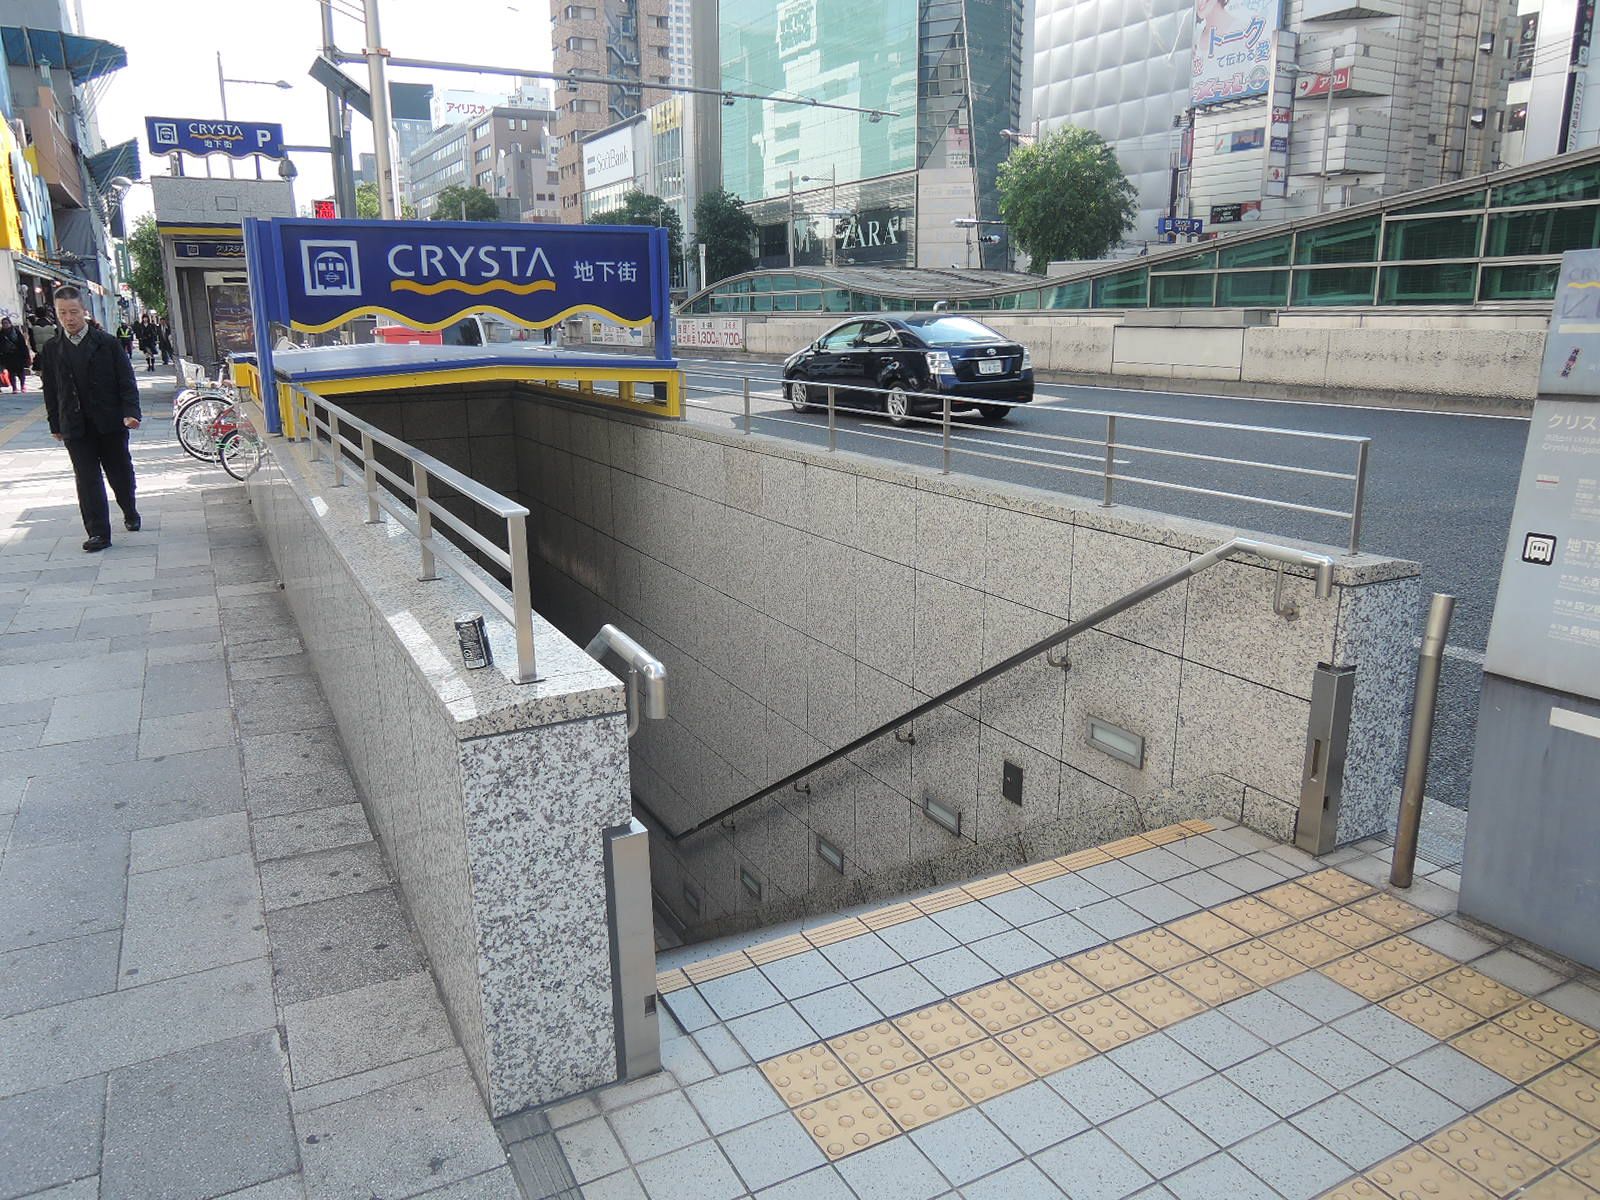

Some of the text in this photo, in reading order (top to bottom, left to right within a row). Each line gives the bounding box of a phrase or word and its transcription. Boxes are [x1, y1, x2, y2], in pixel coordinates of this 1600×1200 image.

[1208, 17, 1266, 58] トーク
[188, 123, 243, 136] CRYSTA
[256, 130, 271, 147] P
[596, 145, 629, 172] SoftBank
[841, 217, 898, 250] ZARA
[387, 244, 555, 278] CRYSTA
[573, 260, 637, 284] 地下街
